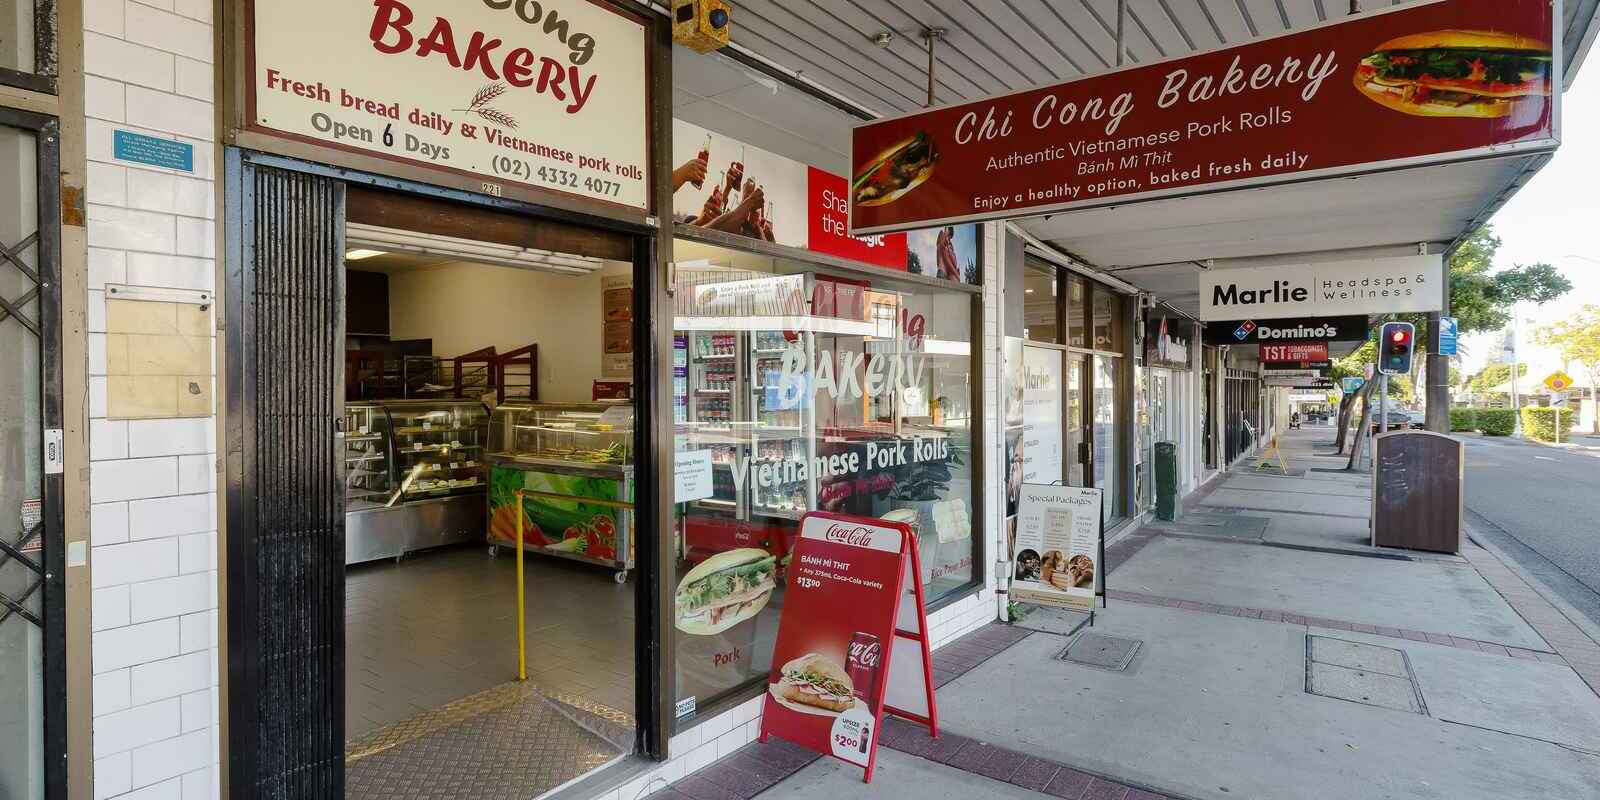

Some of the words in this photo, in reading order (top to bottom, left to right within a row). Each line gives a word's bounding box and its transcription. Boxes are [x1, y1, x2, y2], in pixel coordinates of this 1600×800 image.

[954, 105, 1013, 145] Chi
[1032, 89, 1135, 136] Cong
[1157, 50, 1339, 109] Bakery
[266, 68, 331, 103] Fresh
[340, 88, 400, 121] bread
[408, 108, 453, 137] daily
[460, 122, 477, 140] &
[484, 126, 574, 163] Vietnamese
[578, 153, 611, 174] pork
[615, 156, 643, 181] rolls
[311, 112, 373, 144] Open
[382, 122, 394, 147] 6
[404, 133, 450, 161] Days
[985, 145, 1065, 172] Authentic
[1068, 129, 1181, 157] Vietnamese
[1187, 115, 1233, 140] Pork
[1239, 106, 1292, 131] Rolls
[492, 153, 532, 180] (02)
[537, 164, 578, 189] 4332
[584, 175, 621, 198] 4077
[1077, 158, 1115, 176] Bánh
[482, 183, 500, 197] 221
[974, 191, 1010, 210] Enjoy
[1014, 193, 1023, 203] a
[1028, 182, 1081, 201] healthy
[1087, 174, 1142, 193] option,
[1150, 166, 1201, 186] baked
[1208, 158, 1252, 178] fresh
[1260, 151, 1309, 170] daily
[822, 189, 849, 214] Sha
[822, 212, 845, 237] the
[847, 234, 885, 248] gic
[1212, 280, 1308, 306] Marlie
[1323, 275, 1408, 289] Headspa
[1415, 274, 1426, 284] &
[1323, 287, 1413, 300] Wellness
[1257, 323, 1337, 339] Domino's
[1263, 346, 1287, 360] TST
[780, 349, 926, 406] BAKERY
[730, 450, 860, 492] Vietnamese
[866, 436, 906, 470] Pork
[913, 435, 948, 462] Rolls
[825, 523, 873, 547] Coca-Cola
[833, 574, 862, 585] Coca-Cola
[863, 580, 884, 590] variety
[713, 647, 741, 668] Pork
